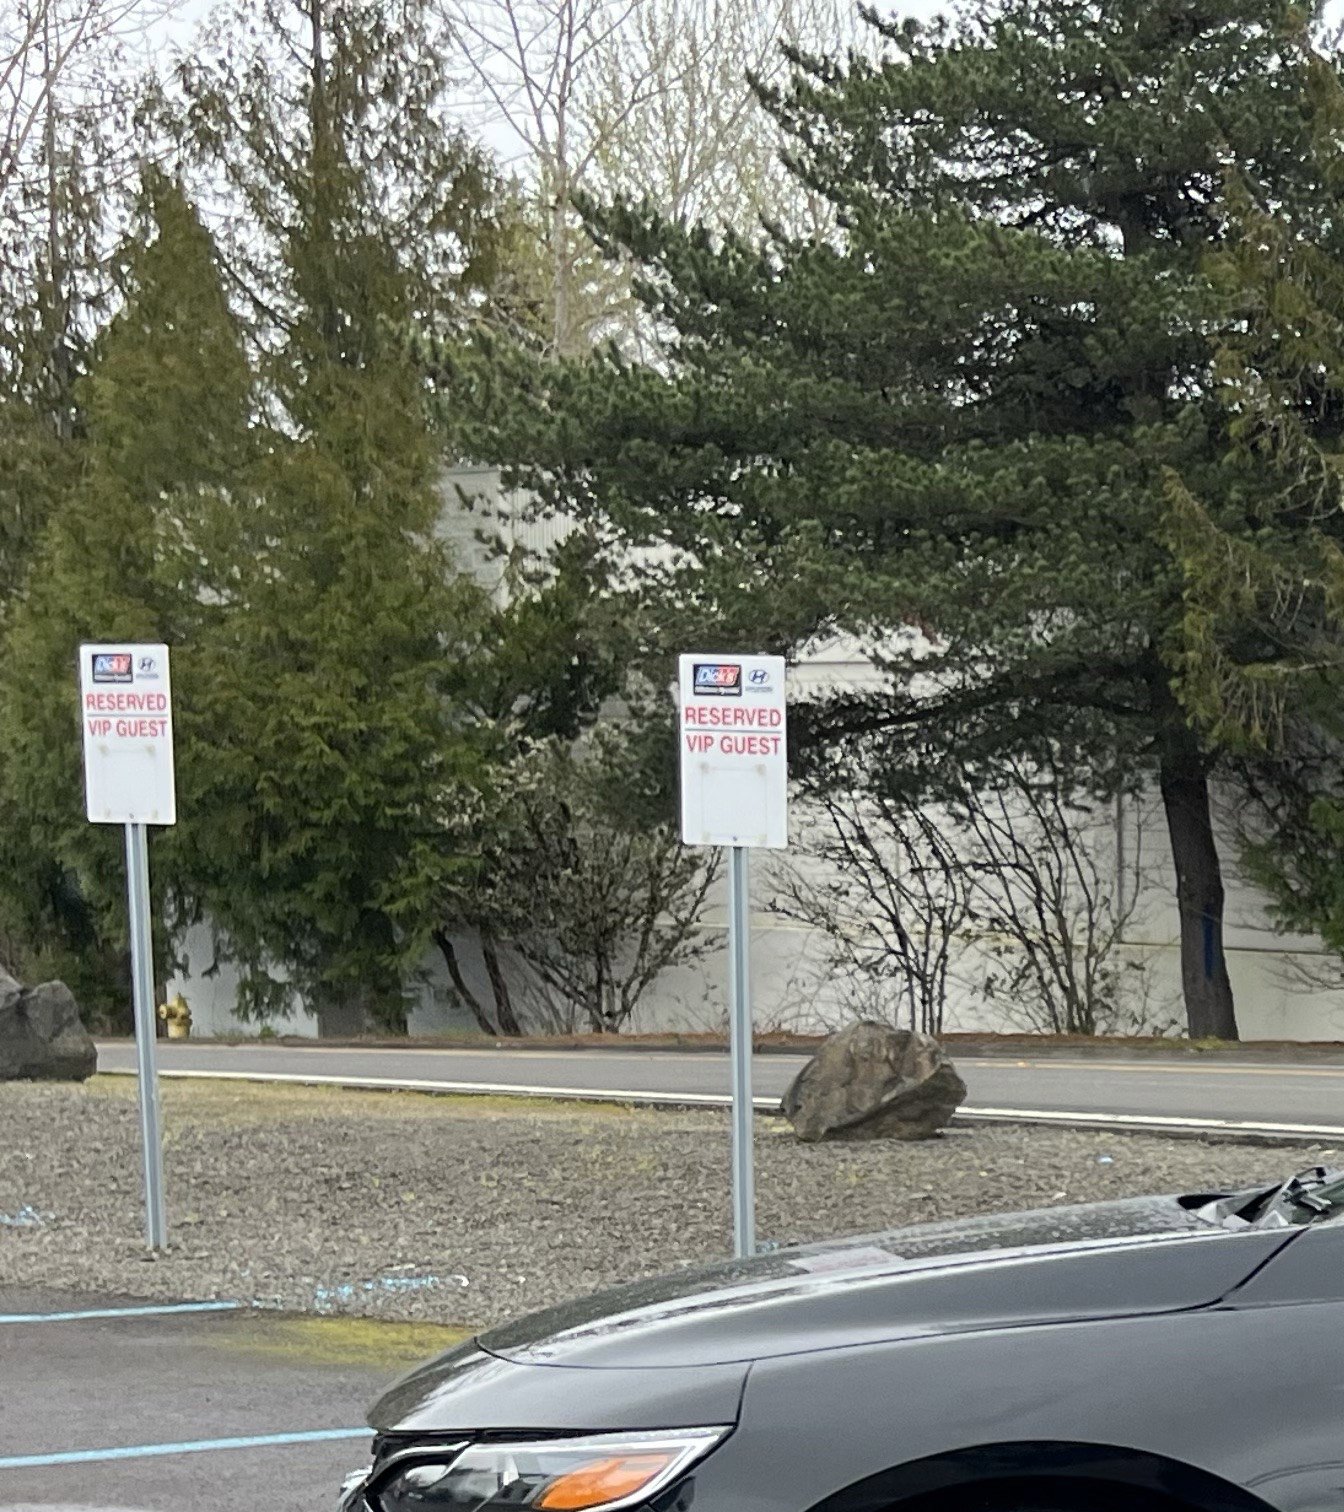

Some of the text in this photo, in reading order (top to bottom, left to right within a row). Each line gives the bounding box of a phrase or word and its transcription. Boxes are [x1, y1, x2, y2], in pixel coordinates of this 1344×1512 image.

[85, 693, 167, 711] RESERVED
[685, 707, 781, 727] RESERVED
[88, 719, 168, 738] VIP GUEST
[686, 735, 781, 755] VIP GUEST
